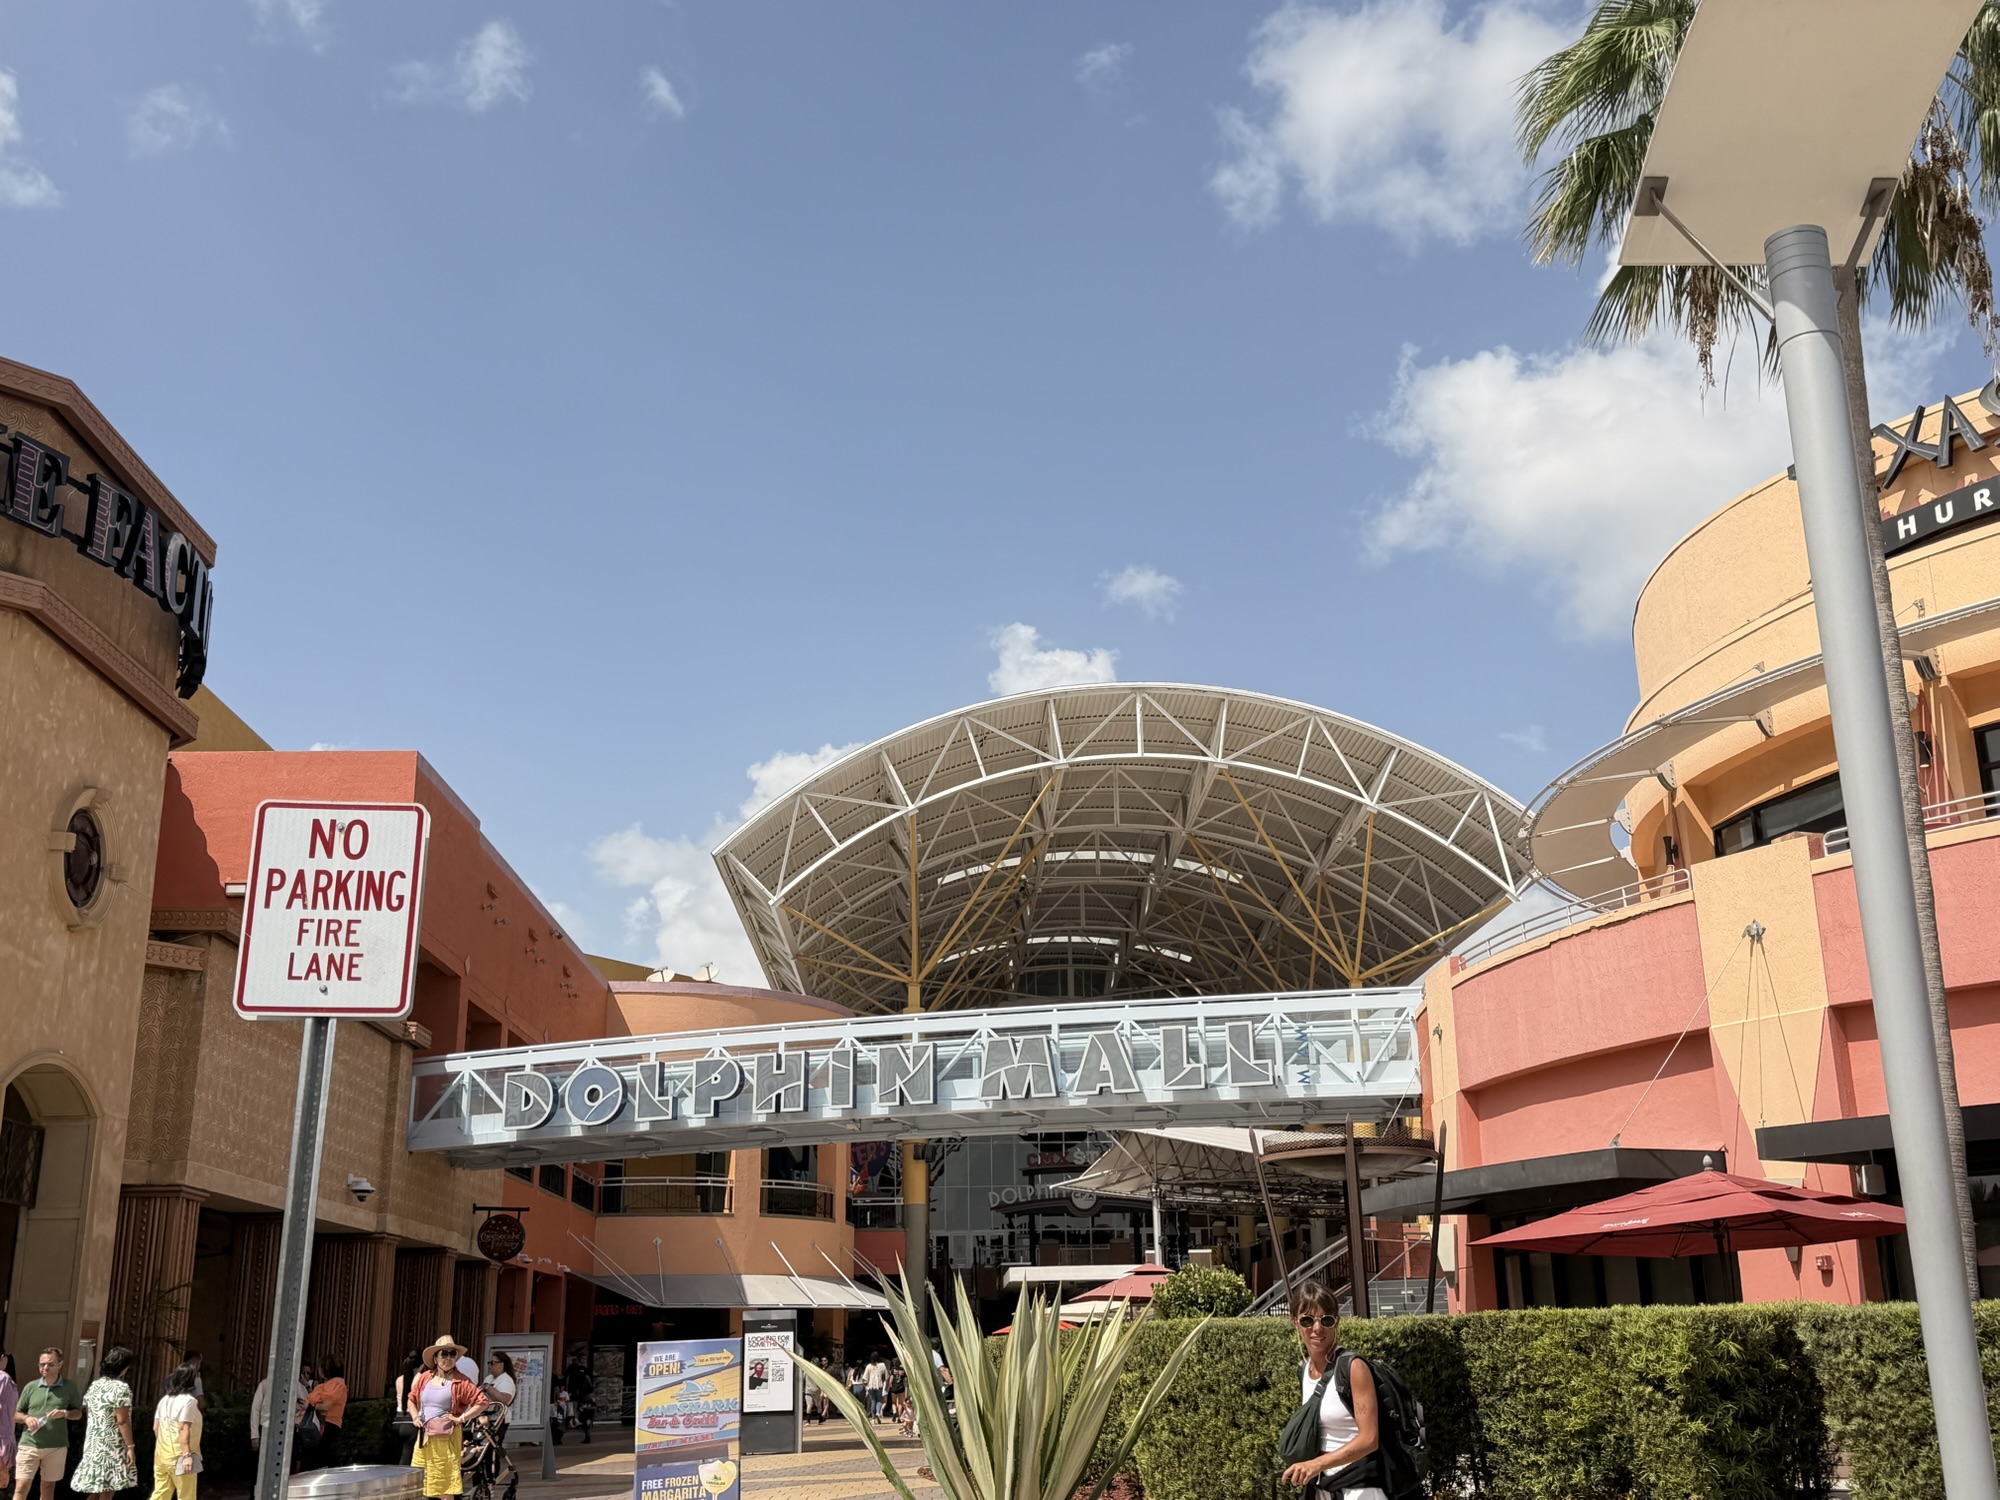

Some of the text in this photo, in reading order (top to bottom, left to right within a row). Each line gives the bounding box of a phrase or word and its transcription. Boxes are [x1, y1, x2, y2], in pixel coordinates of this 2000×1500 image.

[0, 423, 69, 538] E
[1897, 488, 1994, 540] HUR
[308, 818, 370, 861] NO
[263, 868, 407, 912] PARKING
[297, 918, 362, 947] FIRE
[287, 952, 364, 981] LANE
[503, 1021, 1274, 1130] DOLPHIN MALL
[1026, 1151, 1069, 1167] CMX
[649, 1362, 680, 1376] OPEN!
[642, 1398, 738, 1416] LANDSHARK
[647, 1414, 717, 1428] Bar & Grill
[680, 1433, 715, 1444] MIAMI
[641, 1486, 707, 1500] MARGARITA
[642, 1479, 663, 1490] FREE
[665, 1475, 699, 1488] FROZEN
